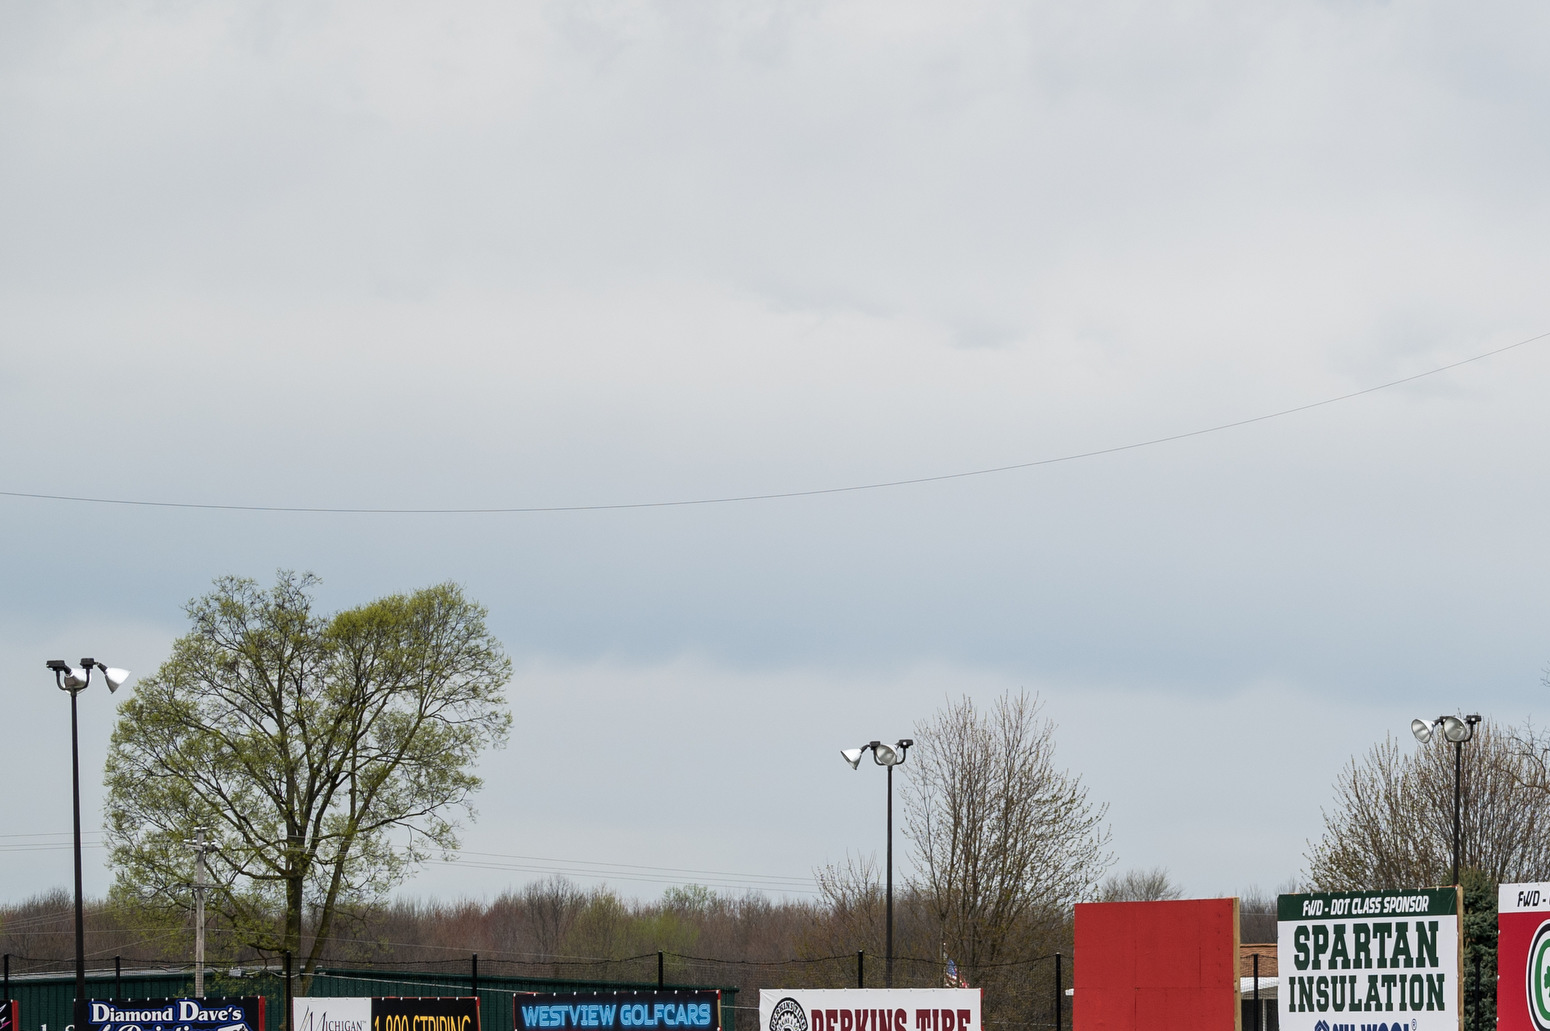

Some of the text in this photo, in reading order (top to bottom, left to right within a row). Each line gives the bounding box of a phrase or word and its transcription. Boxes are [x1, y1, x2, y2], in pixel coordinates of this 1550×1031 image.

[1302, 900, 1323, 917] FWD
[1330, 898, 1350, 915] DOT
[1351, 896, 1382, 915] CLASS
[1382, 895, 1430, 913] SPONSOR
[1517, 890, 1540, 908] FWD
[1293, 920, 1439, 971] SPARTAN
[1288, 973, 1445, 1013] INSULATION
[91, 1001, 242, 1022] Diamond Dave's
[521, 1003, 711, 1027] WESTVIEW GOLFCARS
